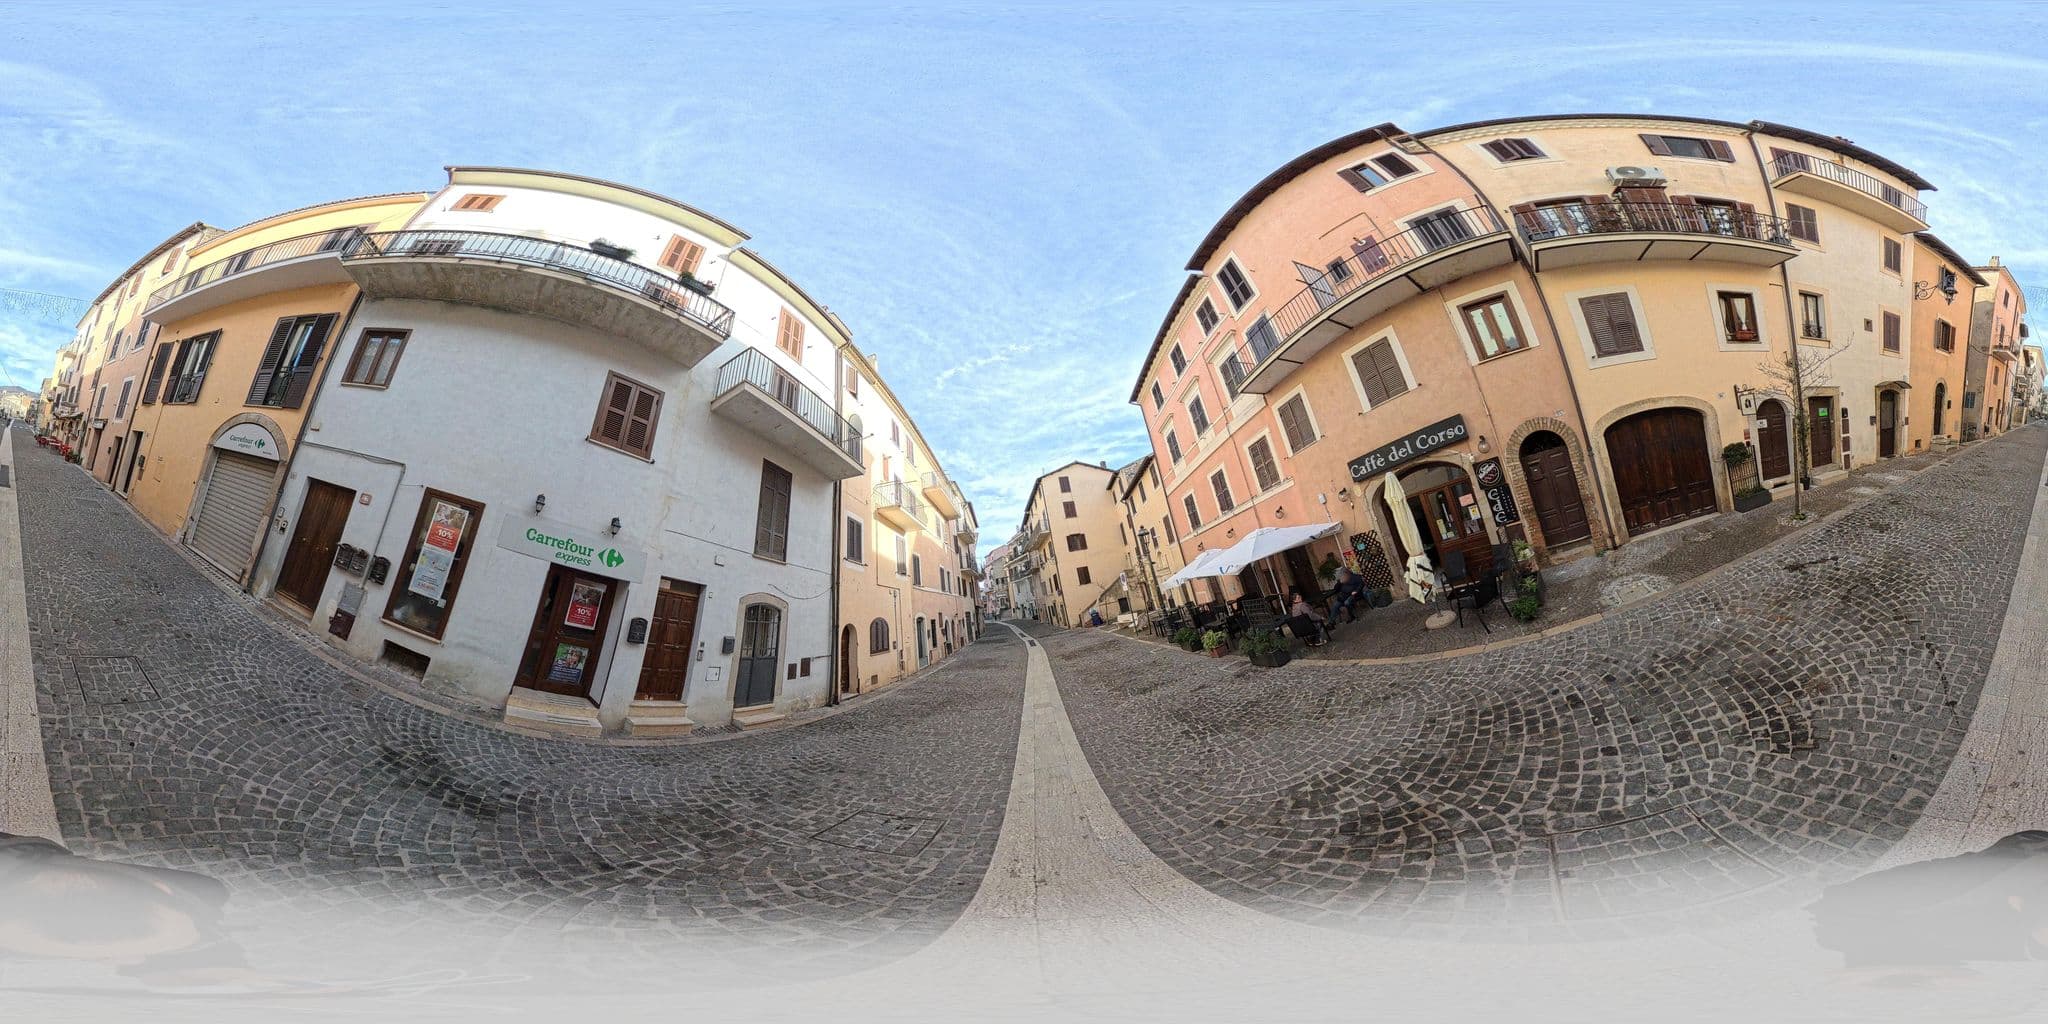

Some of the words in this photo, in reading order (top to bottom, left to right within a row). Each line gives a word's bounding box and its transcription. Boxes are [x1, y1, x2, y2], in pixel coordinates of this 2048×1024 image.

[1350, 454, 1386, 477] Caffè
[1388, 439, 1414, 462] del
[1415, 423, 1465, 449] Corso
[526, 528, 594, 557] Carrefour
[554, 550, 592, 567] express
